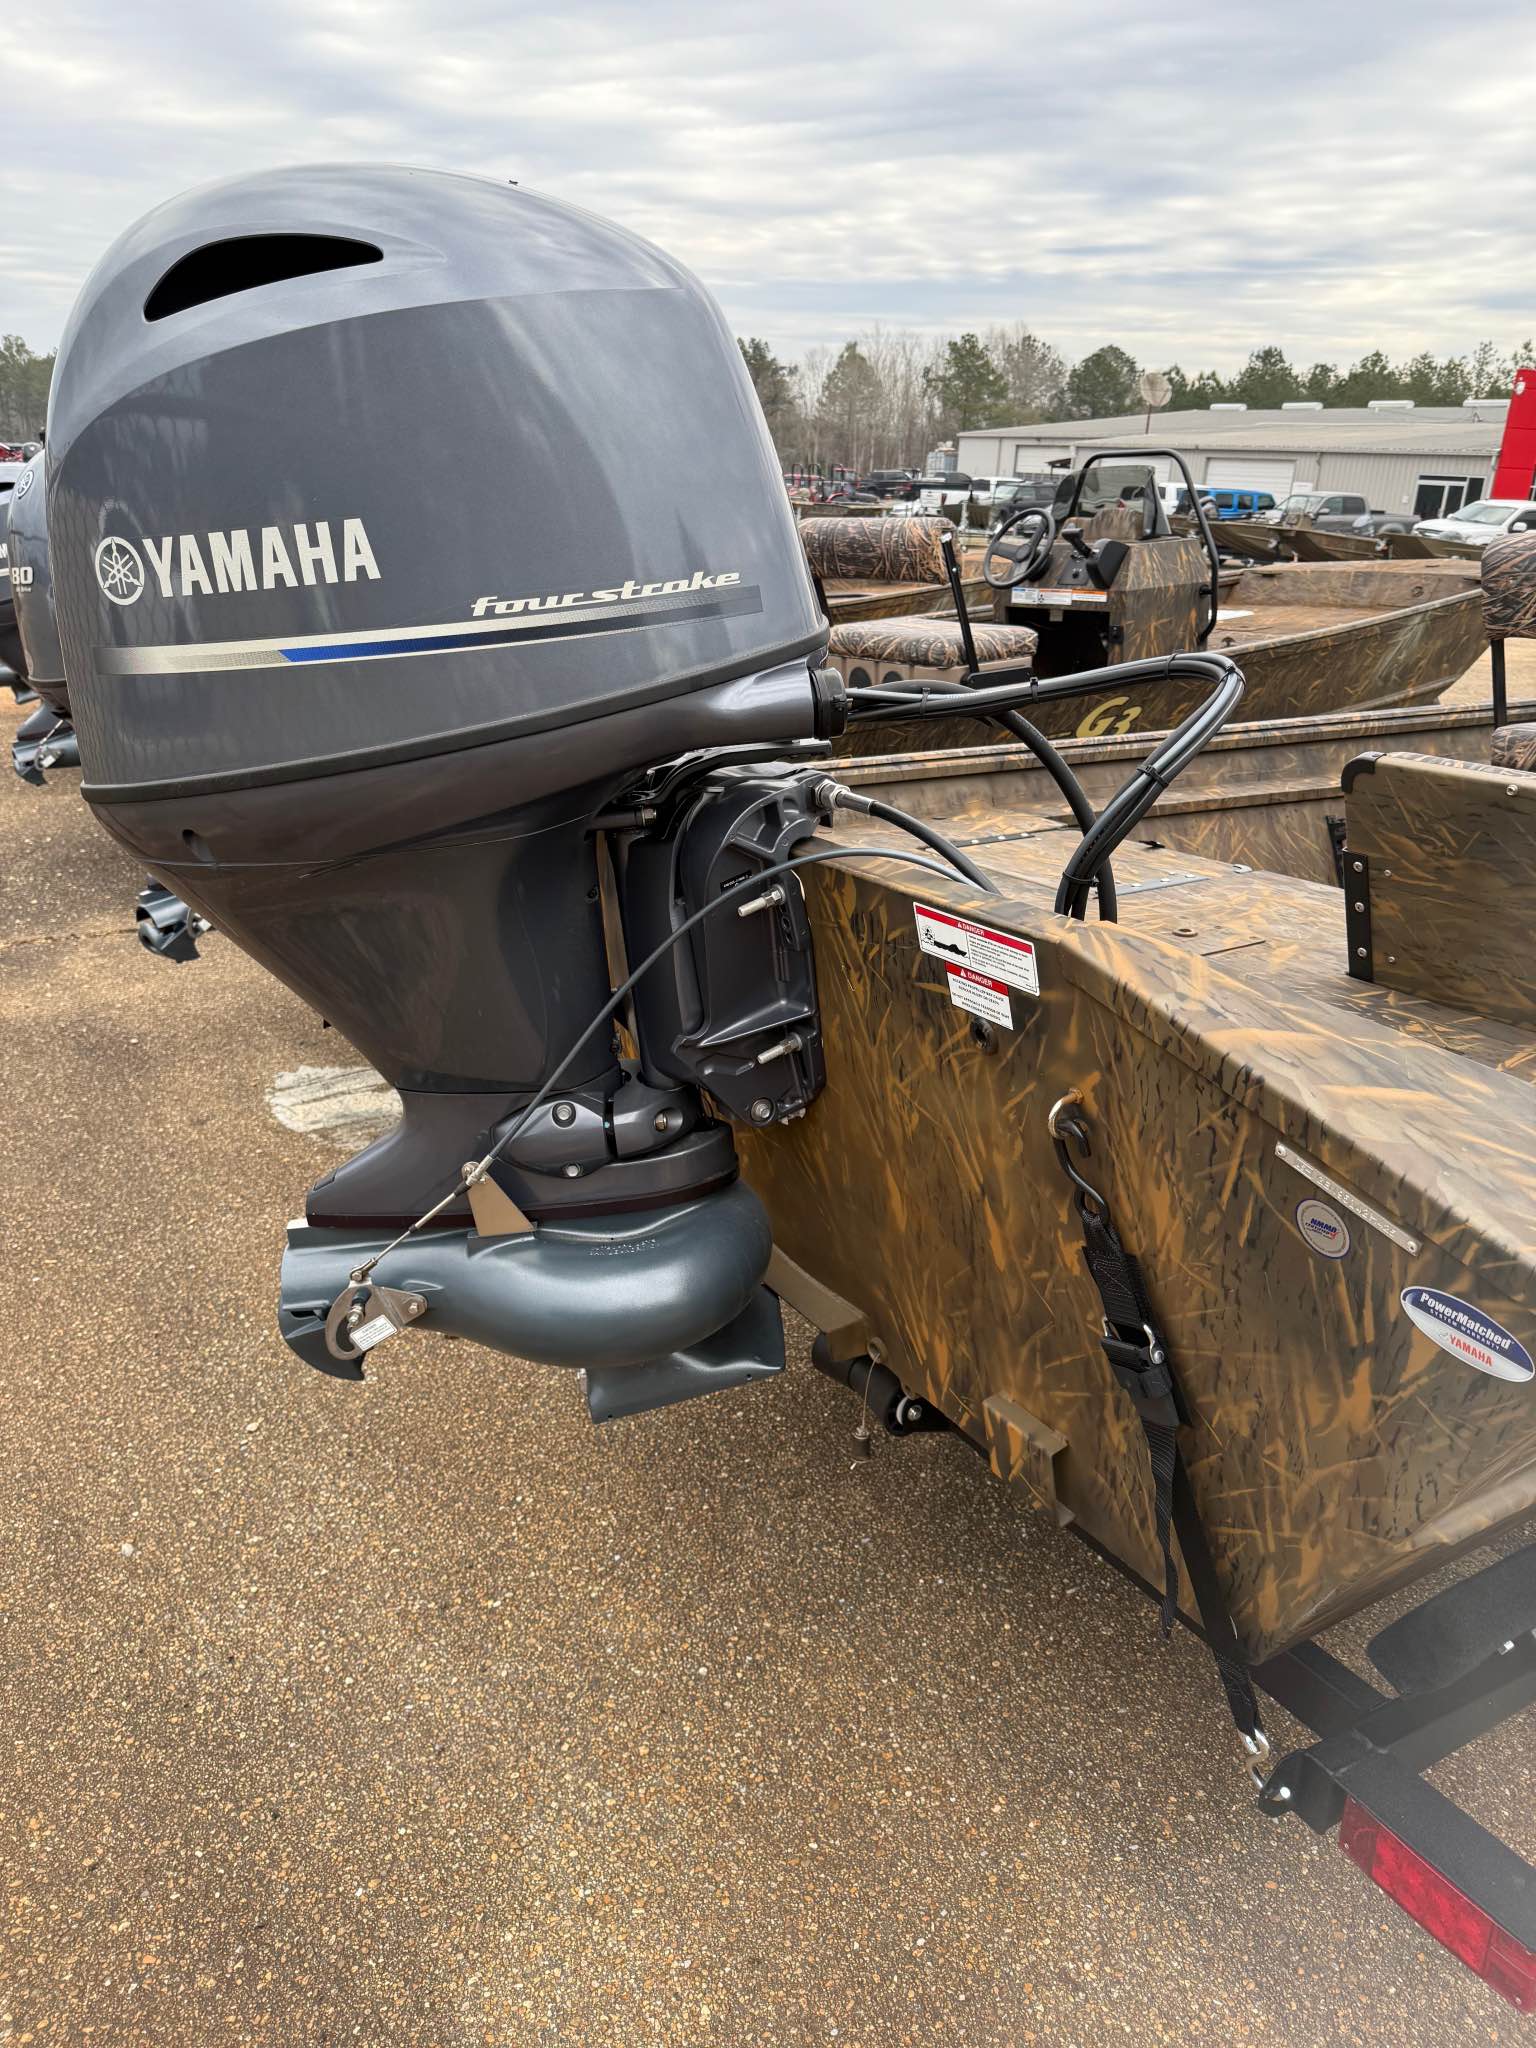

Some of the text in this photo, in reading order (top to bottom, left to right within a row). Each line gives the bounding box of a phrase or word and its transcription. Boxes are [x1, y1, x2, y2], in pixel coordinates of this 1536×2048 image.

[12, 566, 33, 585] 80
[142, 518, 381, 598] YAMAHA
[471, 571, 741, 617] four stroke
[1076, 696, 1143, 738] G3
[962, 923, 985, 936] DANGER
[967, 972, 993, 987] DANGER
[1420, 1292, 1511, 1350] PowerMatched
[1430, 1310, 1499, 1350] SYSTEM WARRANTY
[1450, 1334, 1494, 1367] YAMAHA
